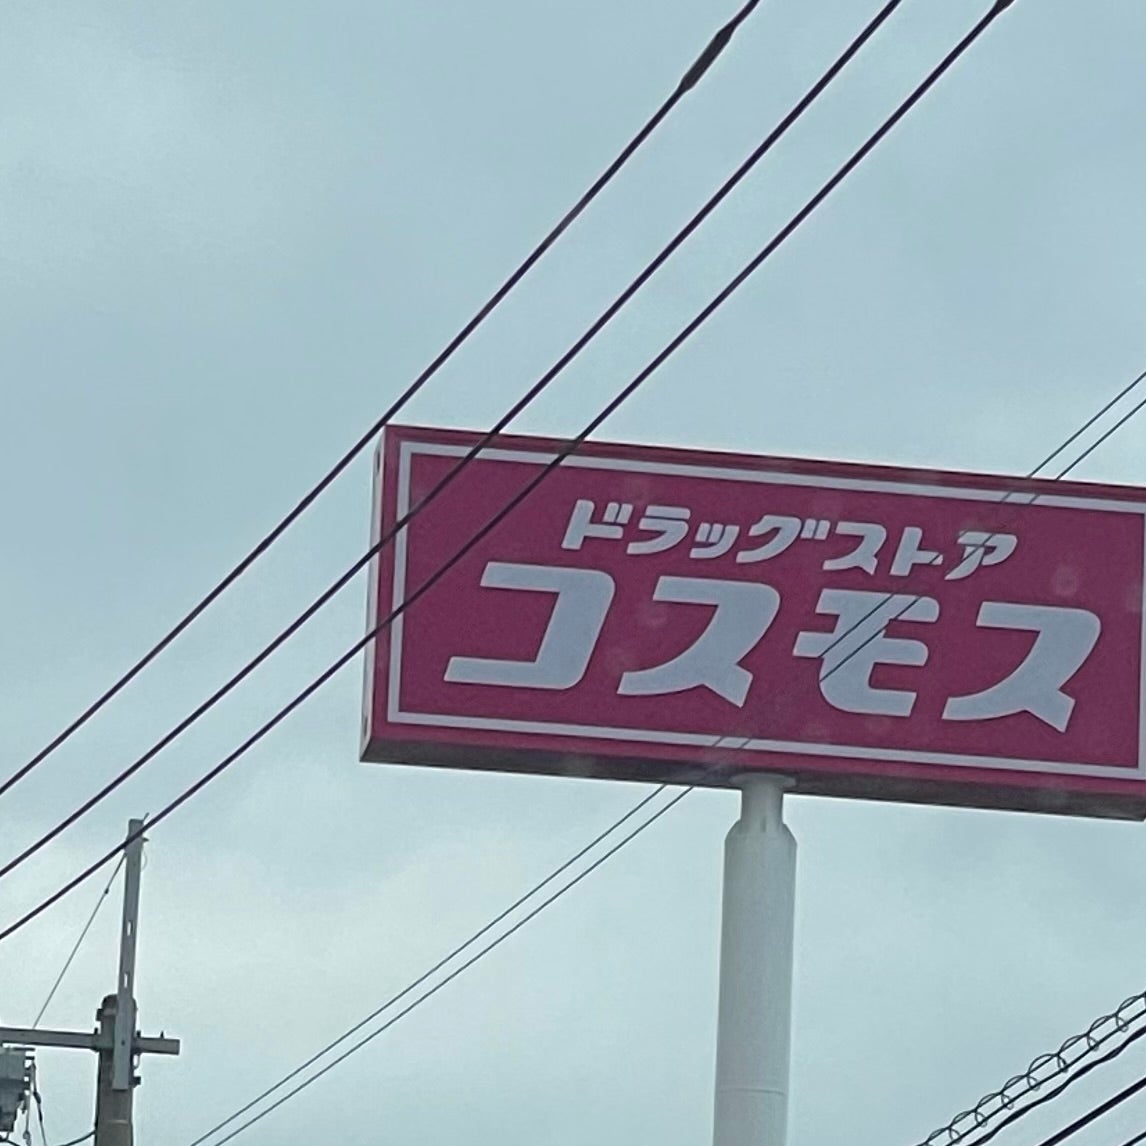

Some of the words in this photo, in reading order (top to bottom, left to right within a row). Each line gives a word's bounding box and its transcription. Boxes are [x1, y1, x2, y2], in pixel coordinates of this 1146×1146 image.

[561, 498, 1018, 580] ドラッグストア
[443, 561, 1102, 733] コスモス
